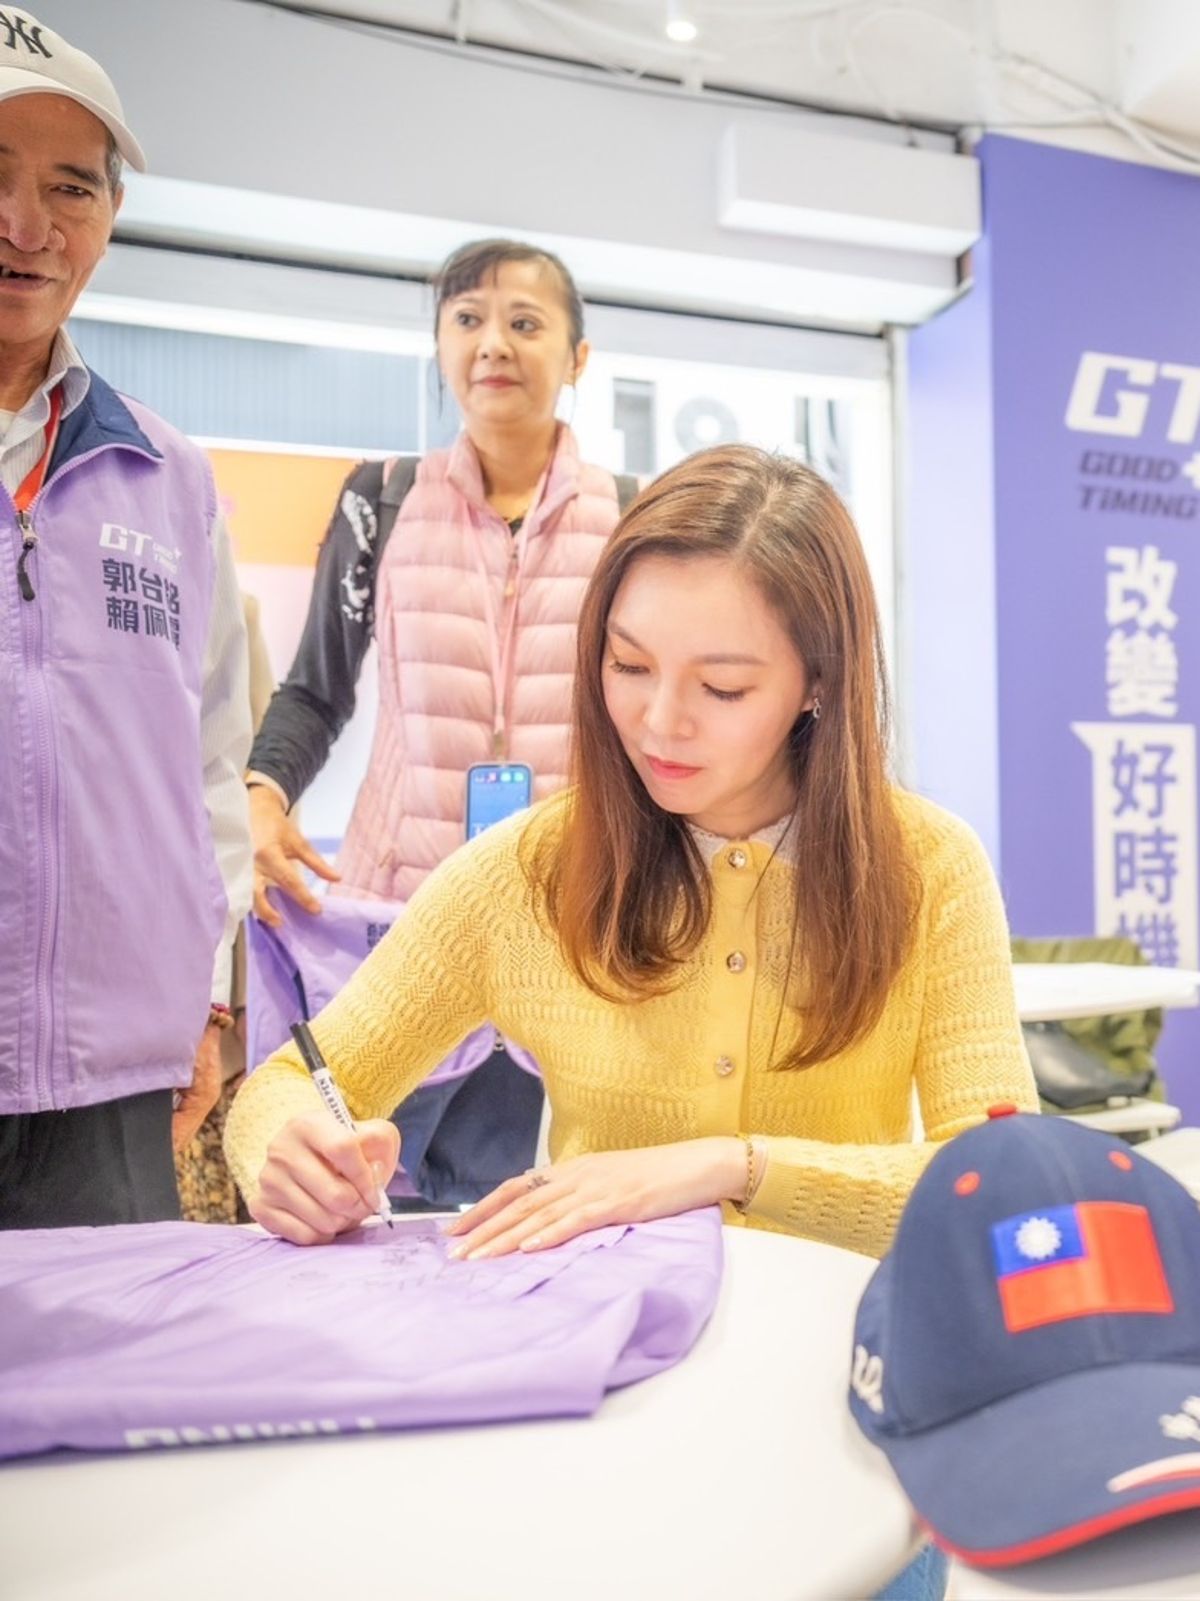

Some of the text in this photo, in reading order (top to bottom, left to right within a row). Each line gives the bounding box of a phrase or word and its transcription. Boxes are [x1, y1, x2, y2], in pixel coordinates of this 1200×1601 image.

[1079, 450, 1179, 483] GOOD
[99, 522, 153, 556] GT
[1105, 545, 1178, 718] 改變
